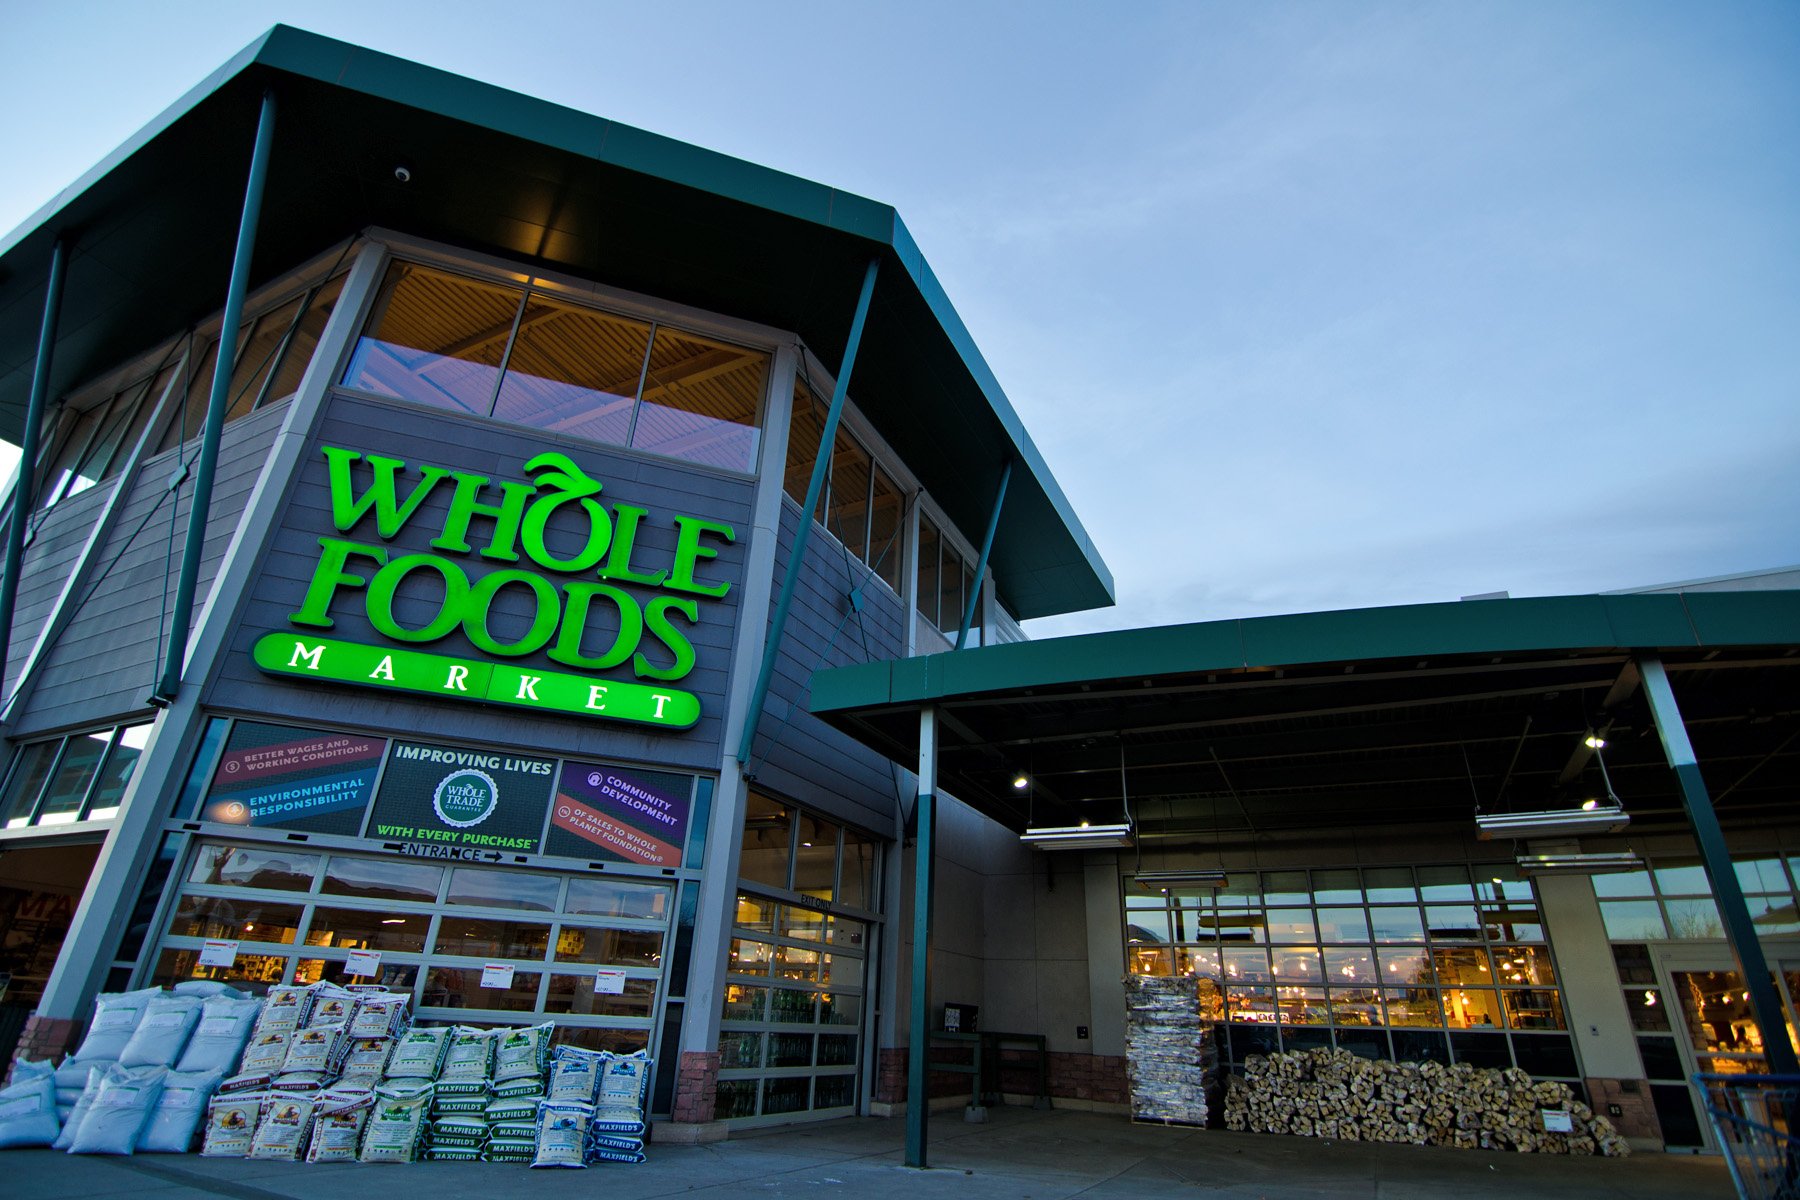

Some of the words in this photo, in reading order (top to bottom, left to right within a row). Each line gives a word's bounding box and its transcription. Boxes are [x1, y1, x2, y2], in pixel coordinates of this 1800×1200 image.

[321, 446, 735, 598] WHOLE
[288, 537, 698, 680] FOODS
[288, 642, 671, 719] MARKET
[244, 750, 285, 762] BETTER
[287, 743, 324, 755] WAGES
[327, 739, 349, 748] AND
[246, 756, 300, 771] WORKING
[302, 744, 369, 762] CONDITIONS
[396, 745, 500, 770] IMPROVING
[504, 759, 552, 775] LIVES
[250, 778, 365, 806] ENVIRONMENTAL
[448, 784, 486, 798] WHOLE
[607, 775, 672, 811] COMMUNITY
[250, 790, 358, 818] RESPONSIBILITY
[445, 804, 481, 812] GUARANTEE
[446, 795, 484, 808] TRADE
[601, 785, 678, 826] DEVELOPMENT
[377, 825, 413, 838] WITH
[416, 828, 460, 842] EVERY
[569, 816, 602, 835] PLANET
[574, 808, 587, 819] OF
[586, 813, 613, 830] SALES
[613, 826, 625, 837] TO
[627, 832, 658, 851] WHOLE
[400, 843, 481, 861] ENTRANCE
[801, 894, 816, 905] EXIT
[816, 898, 832, 910] ONLY
[498, 1087, 537, 1097] MAXFIELD'S
[490, 1110, 531, 1120] MAXFIELD'S
[440, 1126, 483, 1136] MAXFIELD'S
[499, 1128, 536, 1136] MAXFIELD
[599, 1123, 638, 1131] MAXFIELD'S
[432, 1137, 475, 1146] MAXFIELD'S
[597, 1138, 636, 1150] MAXFIELD'S
[600, 1152, 638, 1163] MAXFIELD'S
